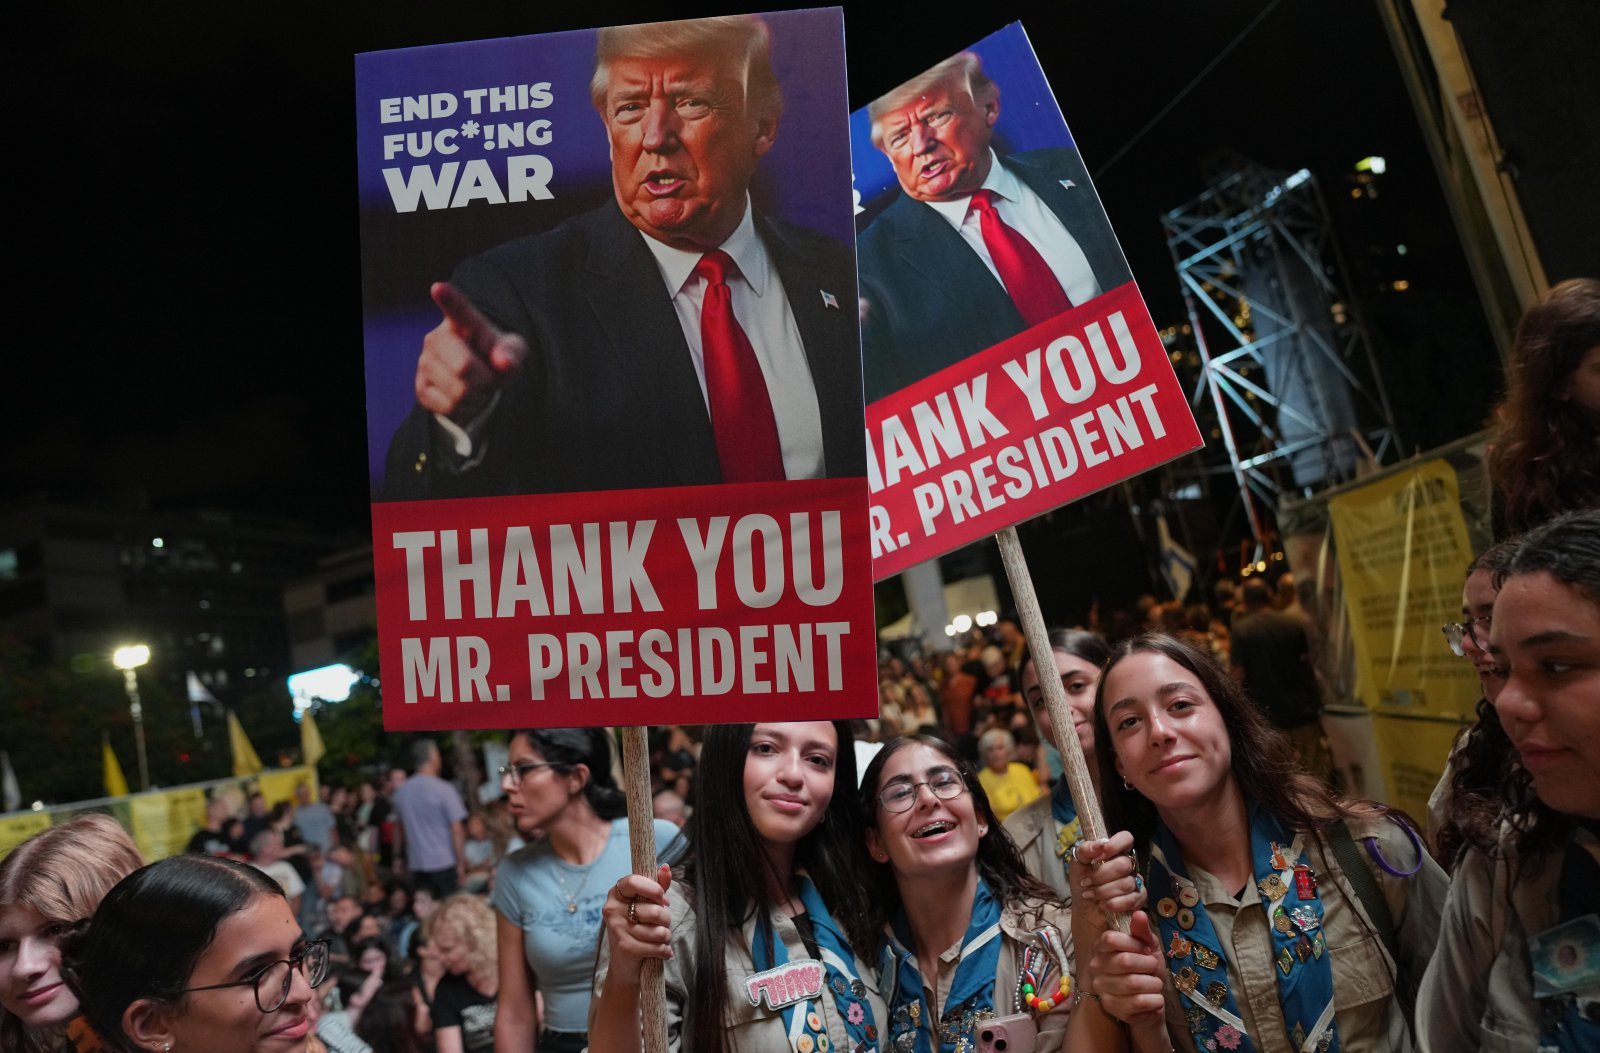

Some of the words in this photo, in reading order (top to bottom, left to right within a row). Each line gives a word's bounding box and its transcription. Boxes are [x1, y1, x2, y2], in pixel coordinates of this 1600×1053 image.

[379, 92, 459, 124] END
[463, 81, 554, 115] THIS
[381, 154, 555, 214] WAR
[864, 373, 1009, 495] ANK
[1002, 311, 1142, 421] YOU
[869, 505, 911, 560] R.
[912, 383, 1167, 536] PRESIDENT
[392, 519, 664, 621] THANK
[677, 510, 844, 610] YOU
[401, 635, 511, 704] MR.
[528, 621, 851, 701] PRESIDENT
